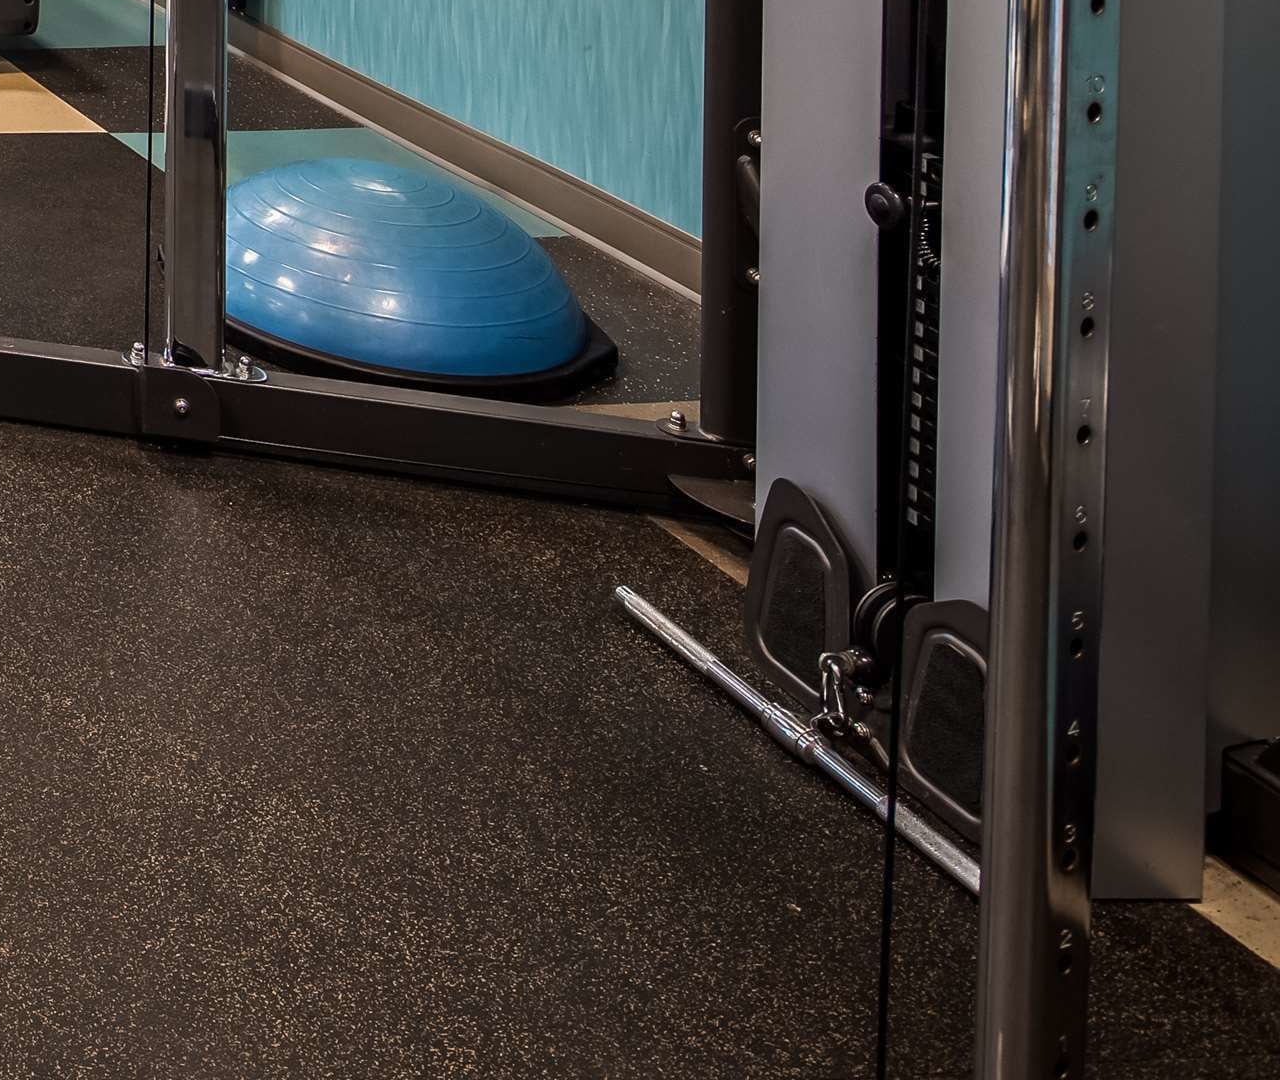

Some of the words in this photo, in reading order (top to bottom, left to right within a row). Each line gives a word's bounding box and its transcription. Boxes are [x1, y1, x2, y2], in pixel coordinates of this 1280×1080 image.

[1071, 611, 1084, 630] 5
[1067, 720, 1080, 737] 4
[1064, 824, 1076, 844] 3
[1060, 929, 1072, 949] 2
